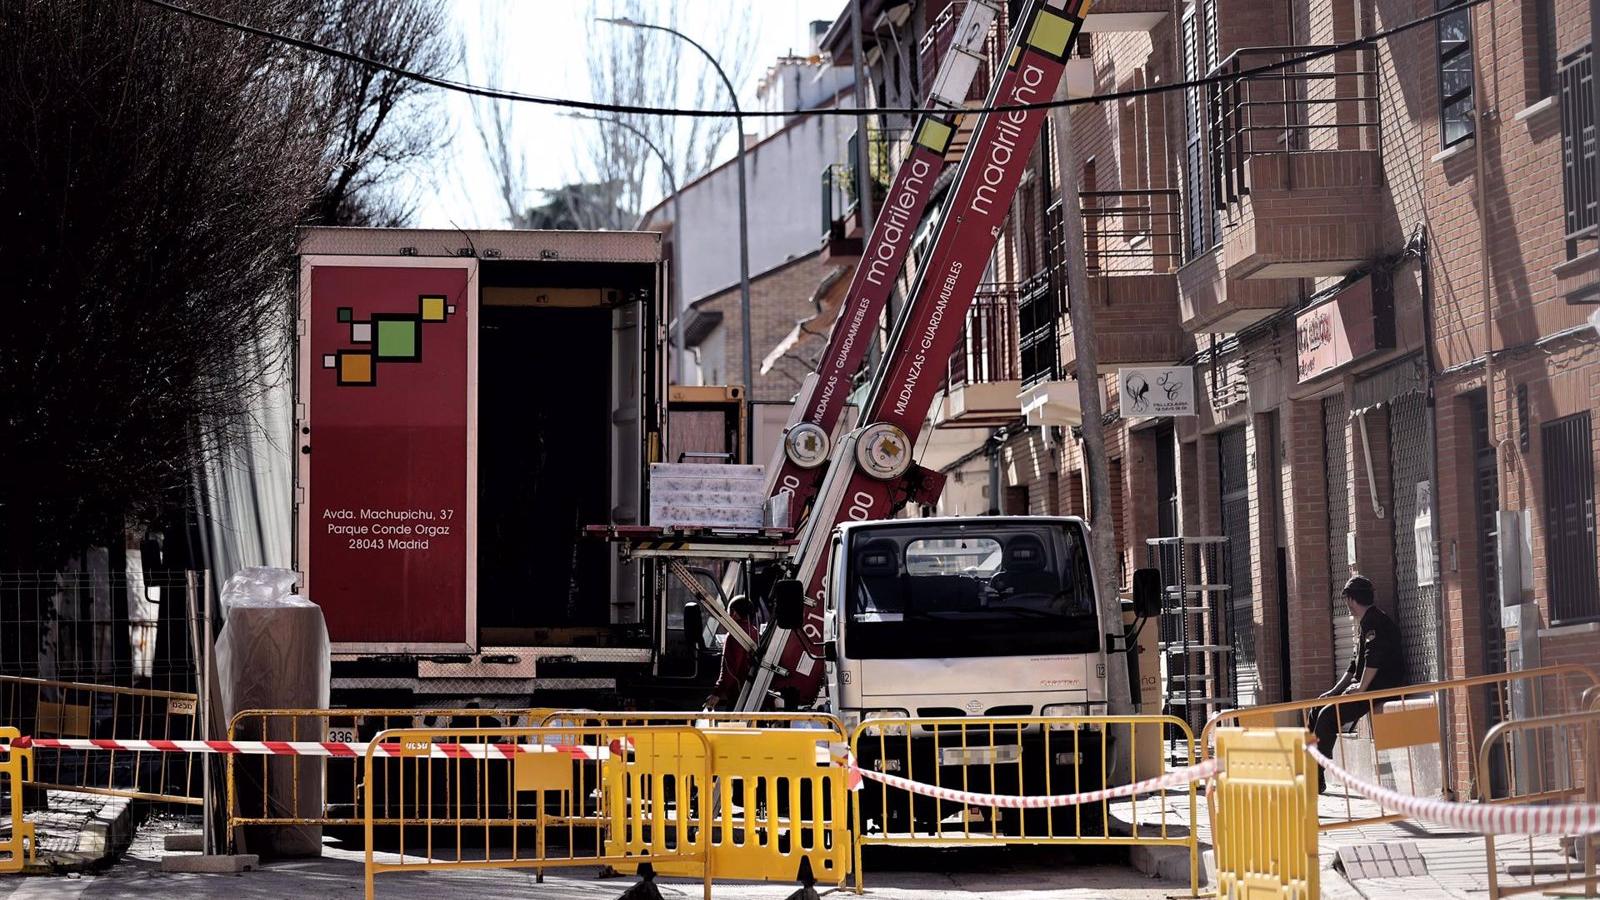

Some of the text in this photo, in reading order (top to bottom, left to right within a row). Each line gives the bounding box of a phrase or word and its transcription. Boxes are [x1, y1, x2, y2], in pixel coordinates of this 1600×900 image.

[970, 64, 1044, 215] madrileña
[866, 158, 930, 286] madrileña
[812, 297, 870, 425] MUDANZAS GUARDAMUEBLES
[893, 261, 963, 416] MUDANZAS GUARDAMUEBLES
[323, 509, 454, 521] Avda. Machupichu, 37
[328, 523, 450, 536] Parque Conde Orgaz
[349, 539, 429, 550] 28043 Madrid
[329, 731, 352, 743] 336
